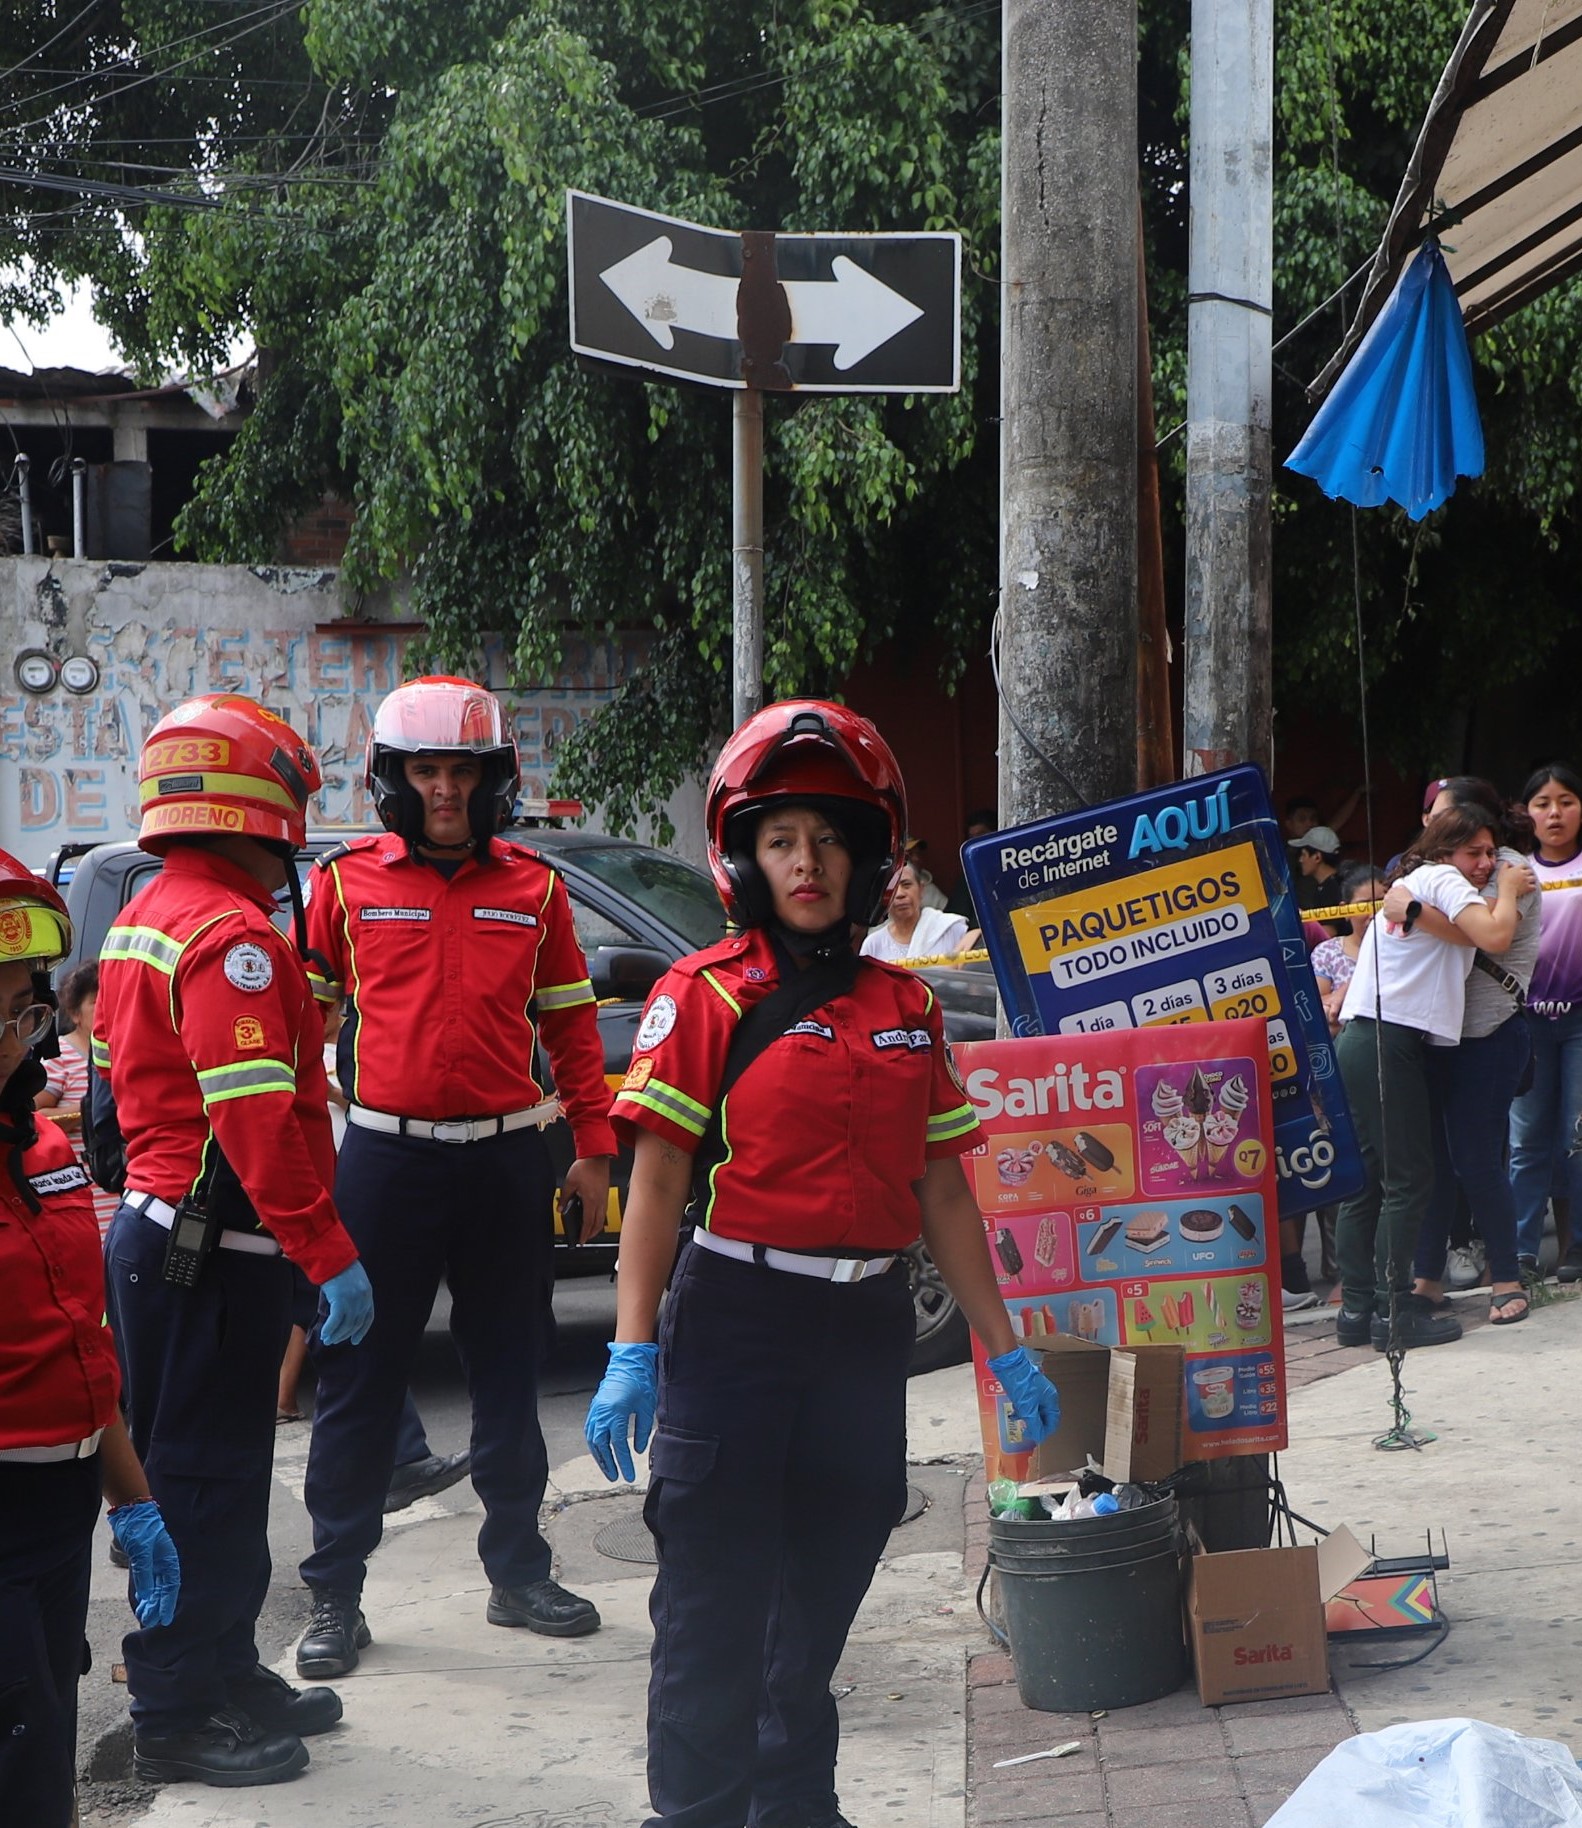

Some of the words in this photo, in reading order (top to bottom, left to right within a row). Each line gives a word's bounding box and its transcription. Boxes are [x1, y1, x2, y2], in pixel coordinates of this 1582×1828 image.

[151, 741, 221, 767] 2733
[19, 768, 108, 832] DE
[154, 806, 239, 827] MORENO
[1000, 825, 1118, 872] Recárgate
[1127, 780, 1231, 860] AQUÍ
[1018, 870, 1040, 889] de
[1043, 850, 1111, 883] Internet
[363, 910, 393, 918] Bombero
[394, 910, 428, 920] Municipal
[1039, 871, 1241, 951] PAQUETIGOS
[1059, 945, 1127, 979] TODO
[1131, 912, 1239, 959] INCLUIDO
[1214, 978, 1227, 994] 3
[1231, 972, 1263, 990] días
[1143, 999, 1157, 1017] 2
[1160, 992, 1193, 1013] días
[1224, 994, 1268, 1020] Q20
[1076, 1020, 1084, 1034] 1
[1090, 1015, 1115, 1033] día
[878, 1032, 908, 1045] Andr
[1268, 1031, 1285, 1045] as
[966, 1062, 1124, 1120] Sarita
[1143, 1121, 1162, 1134] SOFT
[1238, 1149, 1261, 1170] Q7
[998, 1193, 1019, 1201] COPA
[1075, 1184, 1097, 1199] Giga
[1079, 1208, 1095, 1221] Q6
[1192, 1251, 1215, 1261] UFO
[1127, 1284, 1143, 1296] Q5
[1259, 1364, 1275, 1375] Q55
[1260, 1383, 1276, 1394] Q35
[1135, 1388, 1151, 1445] Sarita
[1261, 1402, 1277, 1413] Q22
[1234, 1644, 1292, 1666] Sarita
